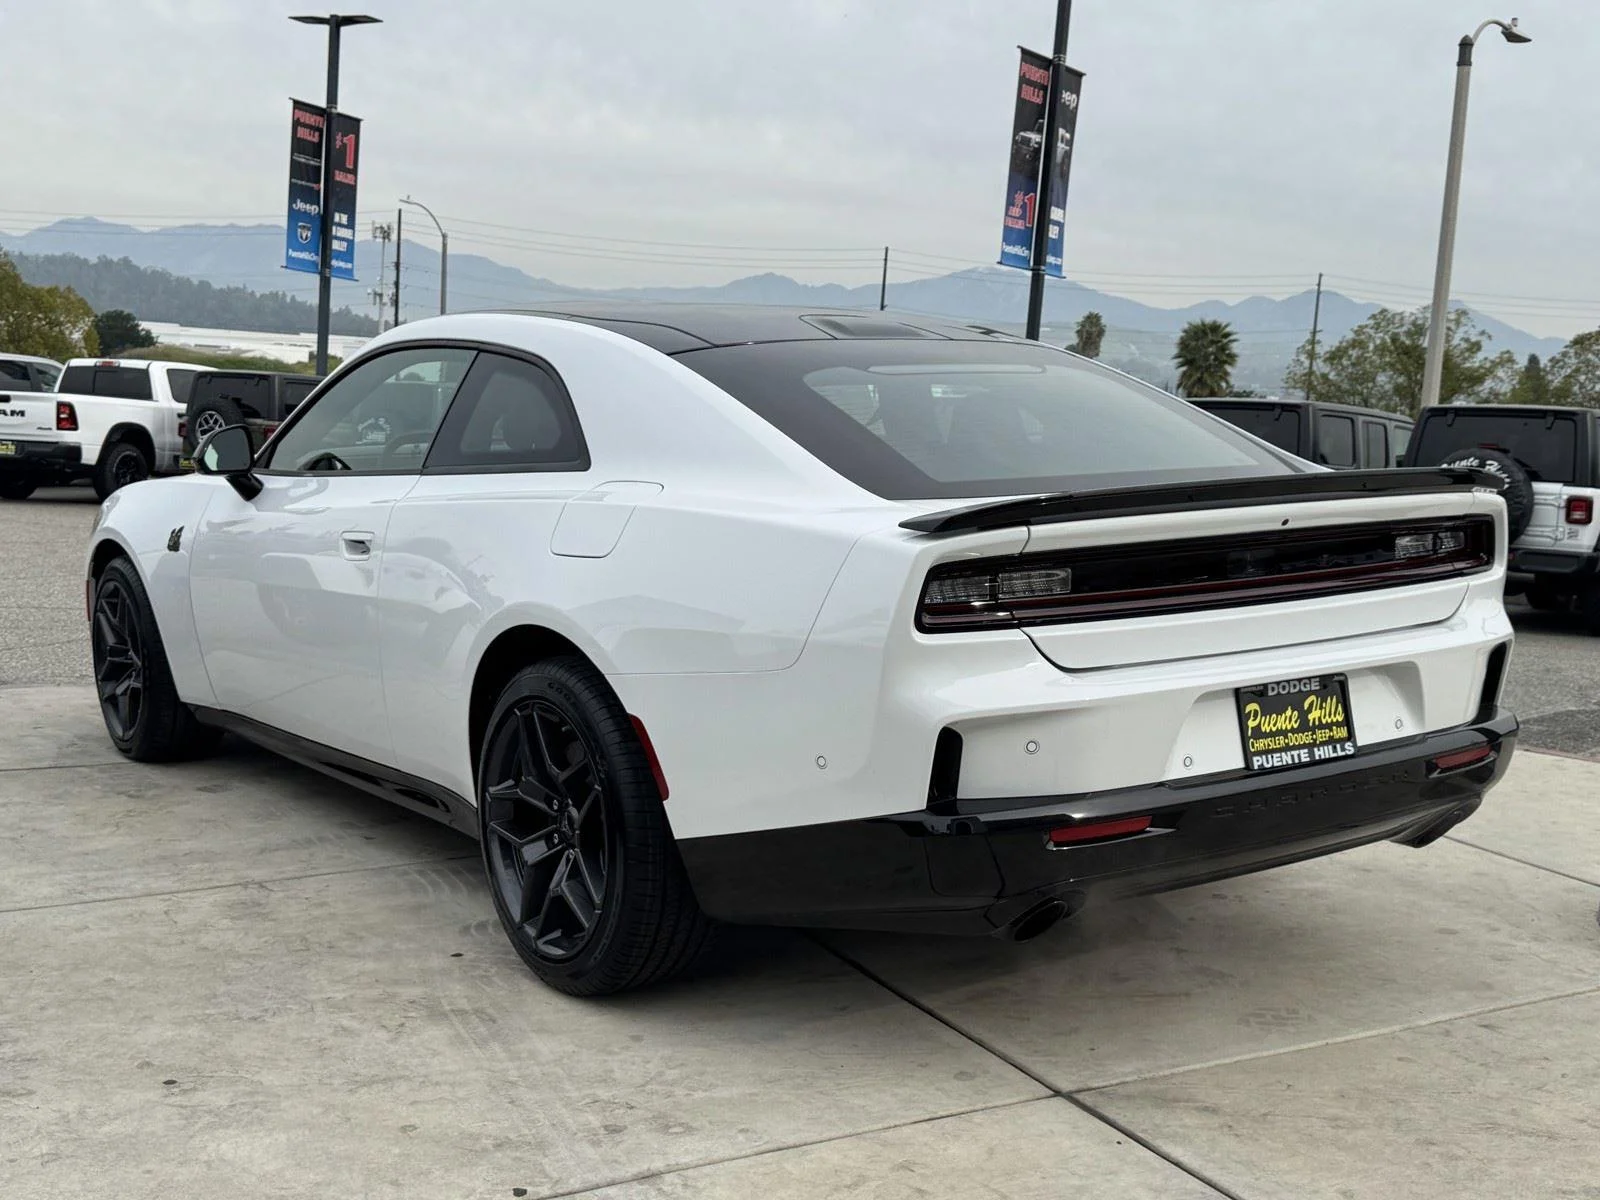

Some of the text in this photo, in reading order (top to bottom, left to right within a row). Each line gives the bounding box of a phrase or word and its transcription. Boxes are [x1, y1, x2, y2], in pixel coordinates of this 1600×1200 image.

[1020, 84, 1044, 105] HILLS
[297, 126, 321, 144] HILLS
[292, 198, 320, 216] Jeep
[0, 409, 26, 417] AM
[1267, 677, 1321, 696] DODGE
[1244, 694, 1345, 736] Puente Hills
[1248, 735, 1286, 752] CHRYSLER
[1252, 742, 1355, 770] PUENTE HILLS
